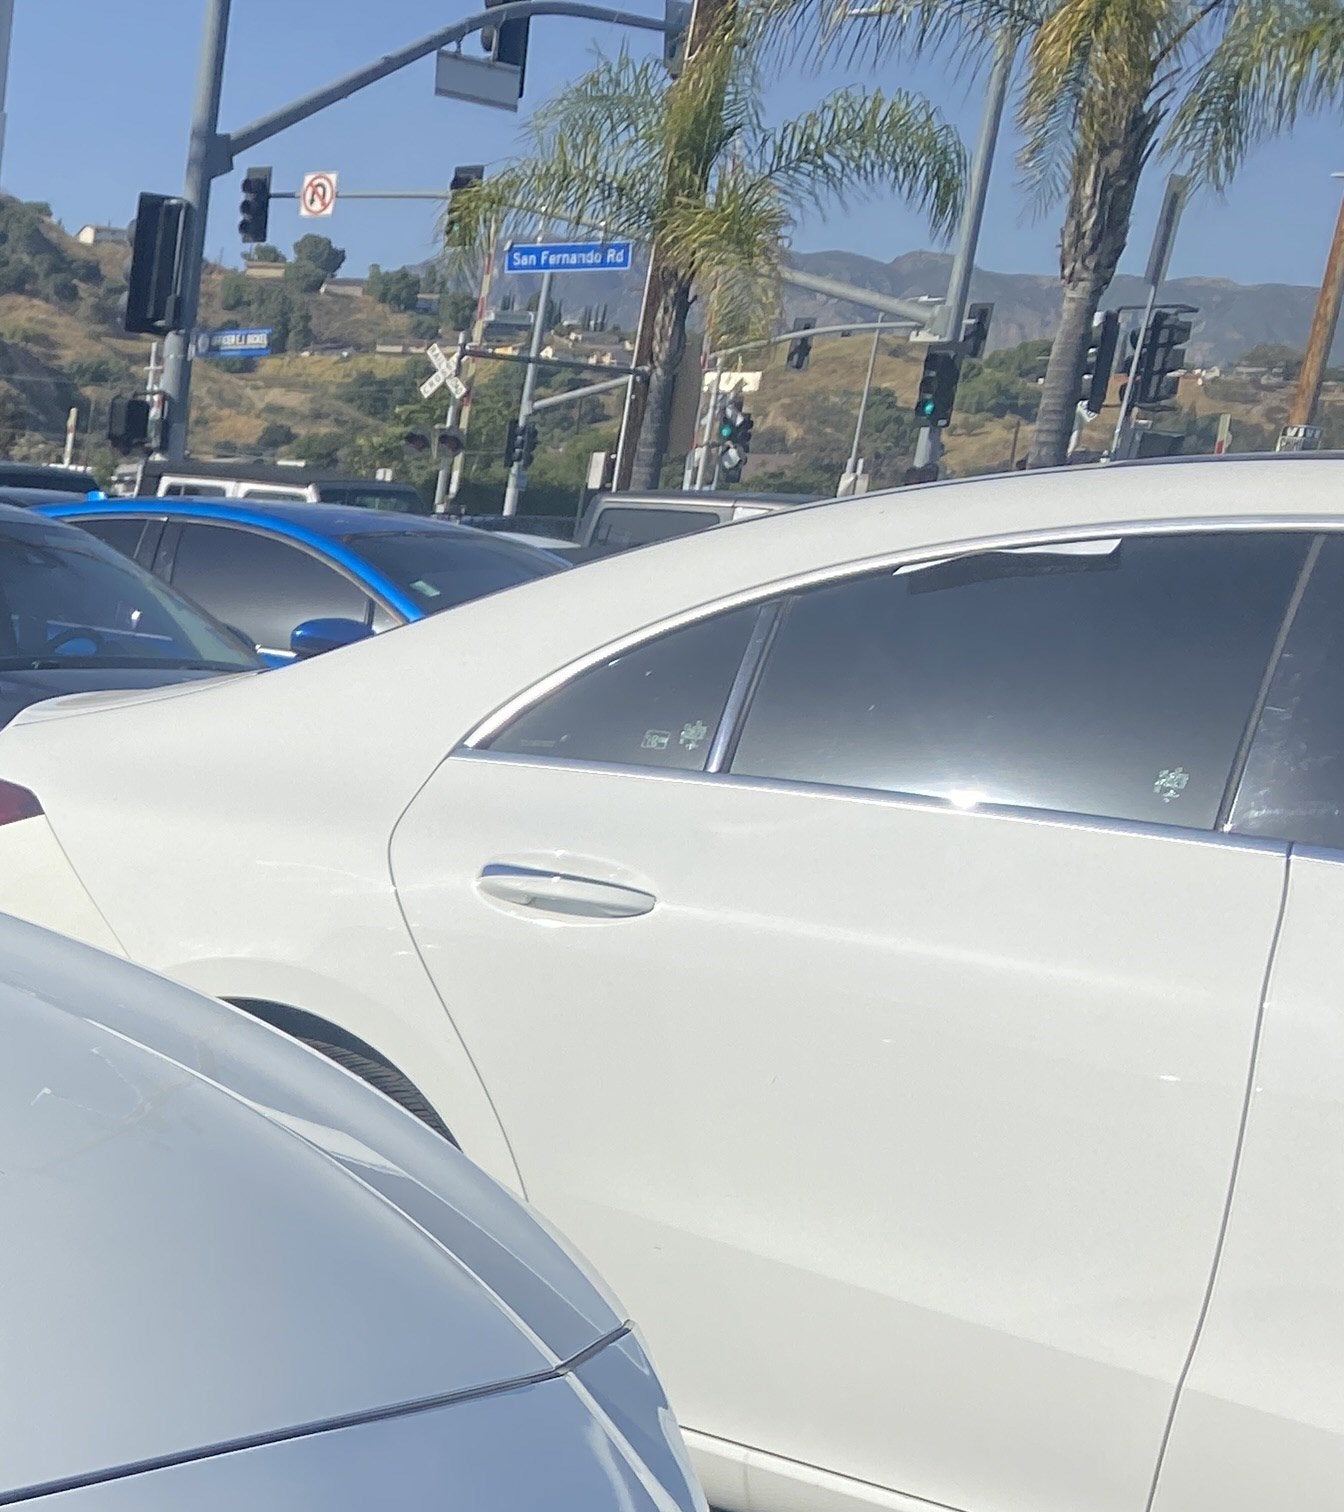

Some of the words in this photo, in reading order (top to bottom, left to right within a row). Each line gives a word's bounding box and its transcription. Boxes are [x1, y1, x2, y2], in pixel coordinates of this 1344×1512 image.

[513, 252, 537, 266] San
[540, 248, 602, 266] Fernando
[606, 248, 624, 263] Rd
